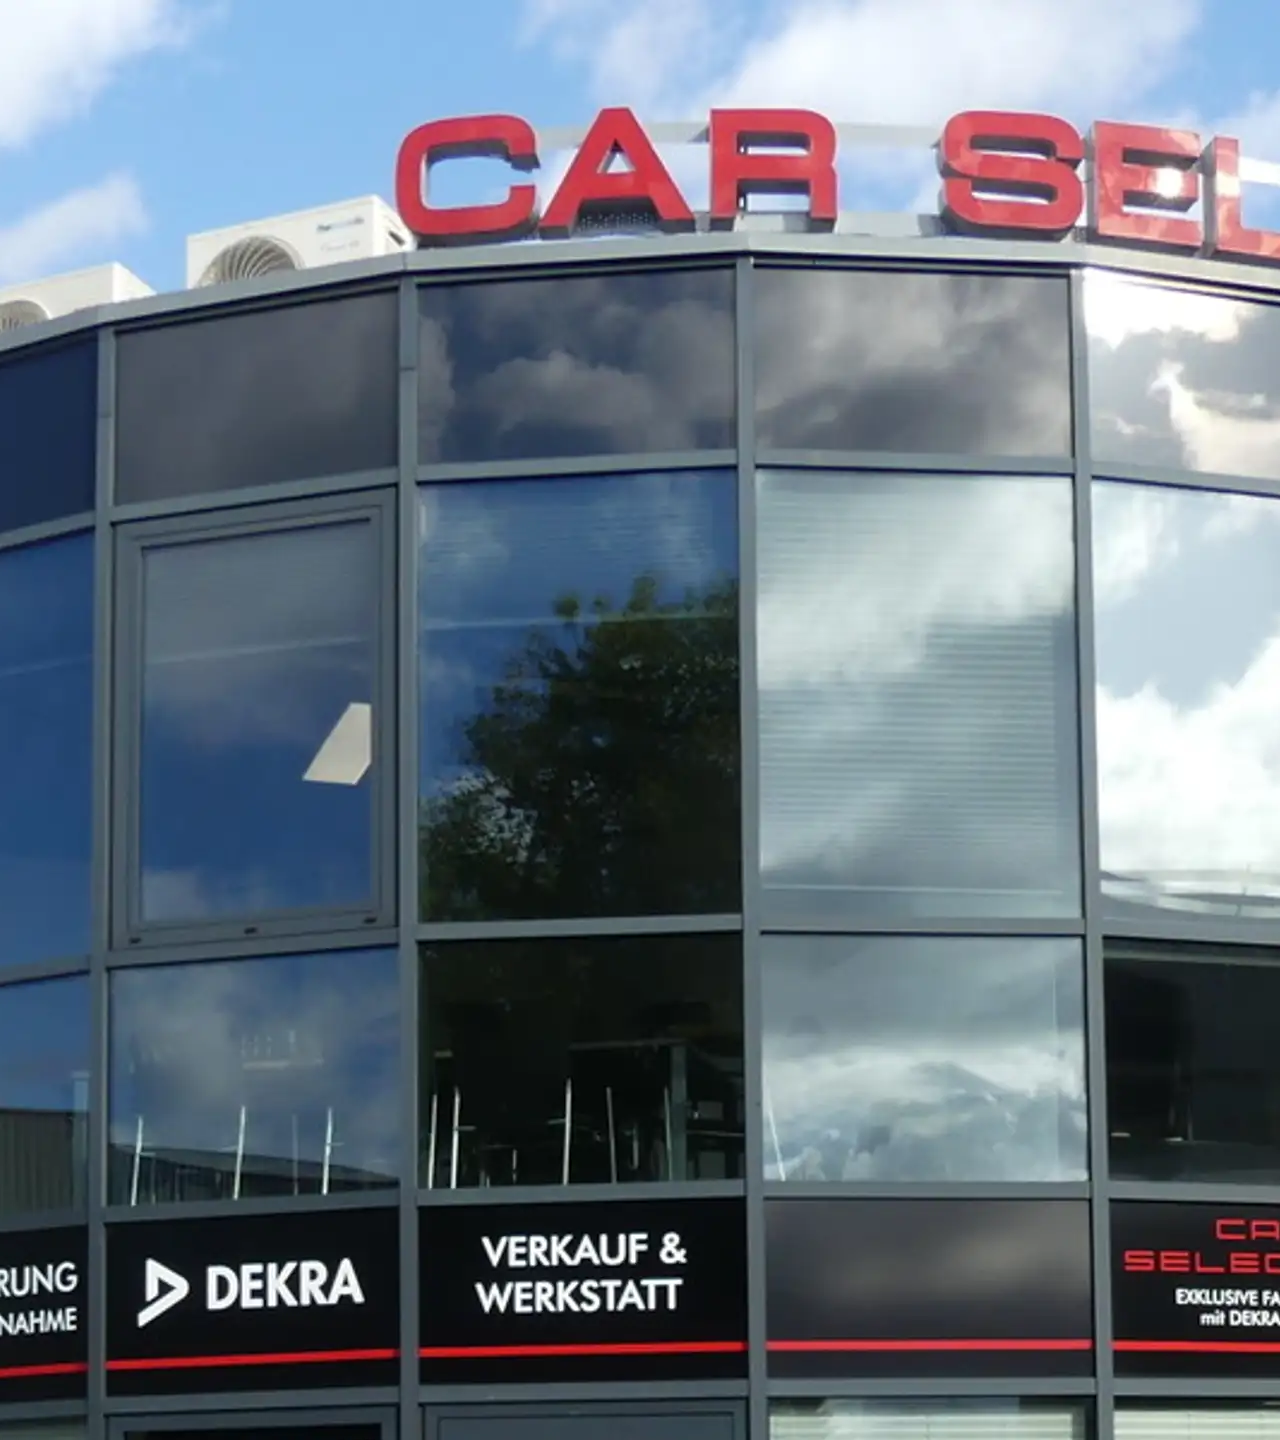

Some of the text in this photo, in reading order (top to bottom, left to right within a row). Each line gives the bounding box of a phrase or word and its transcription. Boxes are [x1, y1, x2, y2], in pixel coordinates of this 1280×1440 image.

[395, 107, 838, 237] CAR
[481, 1231, 687, 1268] VERKAUF &
[205, 1257, 365, 1311] DEKRA
[474, 1278, 683, 1313] WERKSTATT
[1175, 1287, 1259, 1307] EXKLUSIVE
[1199, 1308, 1226, 1327] mit
